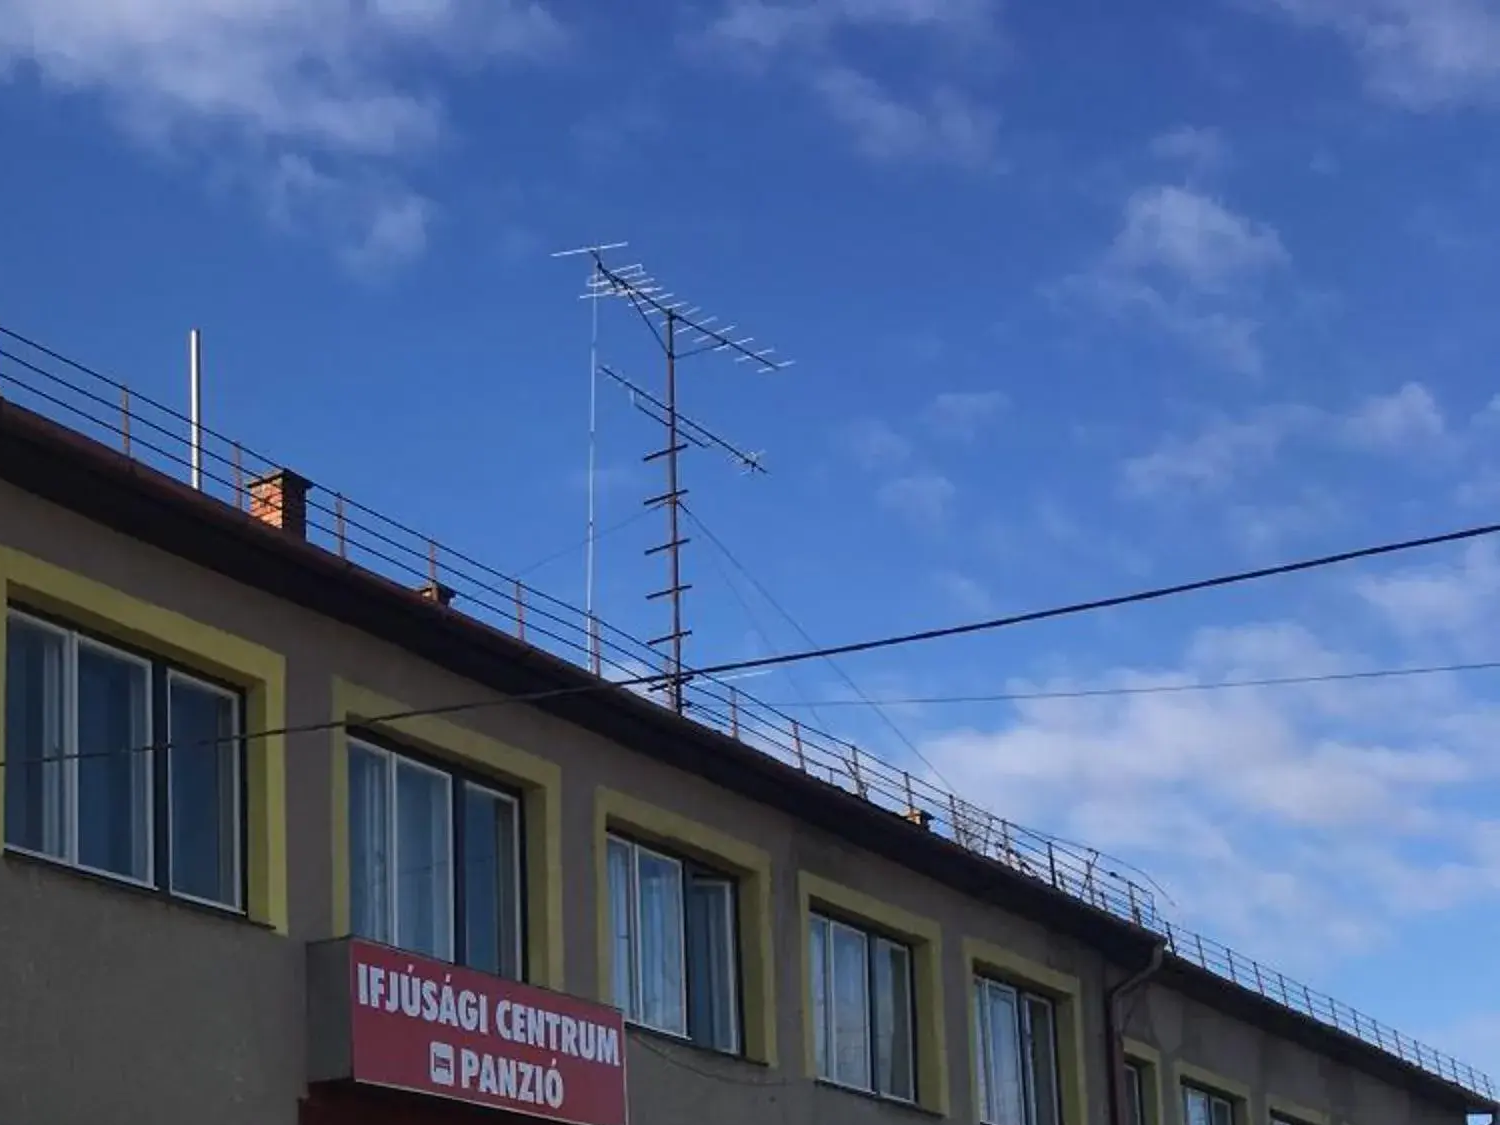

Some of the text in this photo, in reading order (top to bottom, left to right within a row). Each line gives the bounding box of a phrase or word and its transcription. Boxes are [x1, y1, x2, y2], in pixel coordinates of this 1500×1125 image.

[357, 963, 620, 1066] IFJÚSÁGI CENTRUM
[461, 1048, 565, 1109] PANZIÓ
